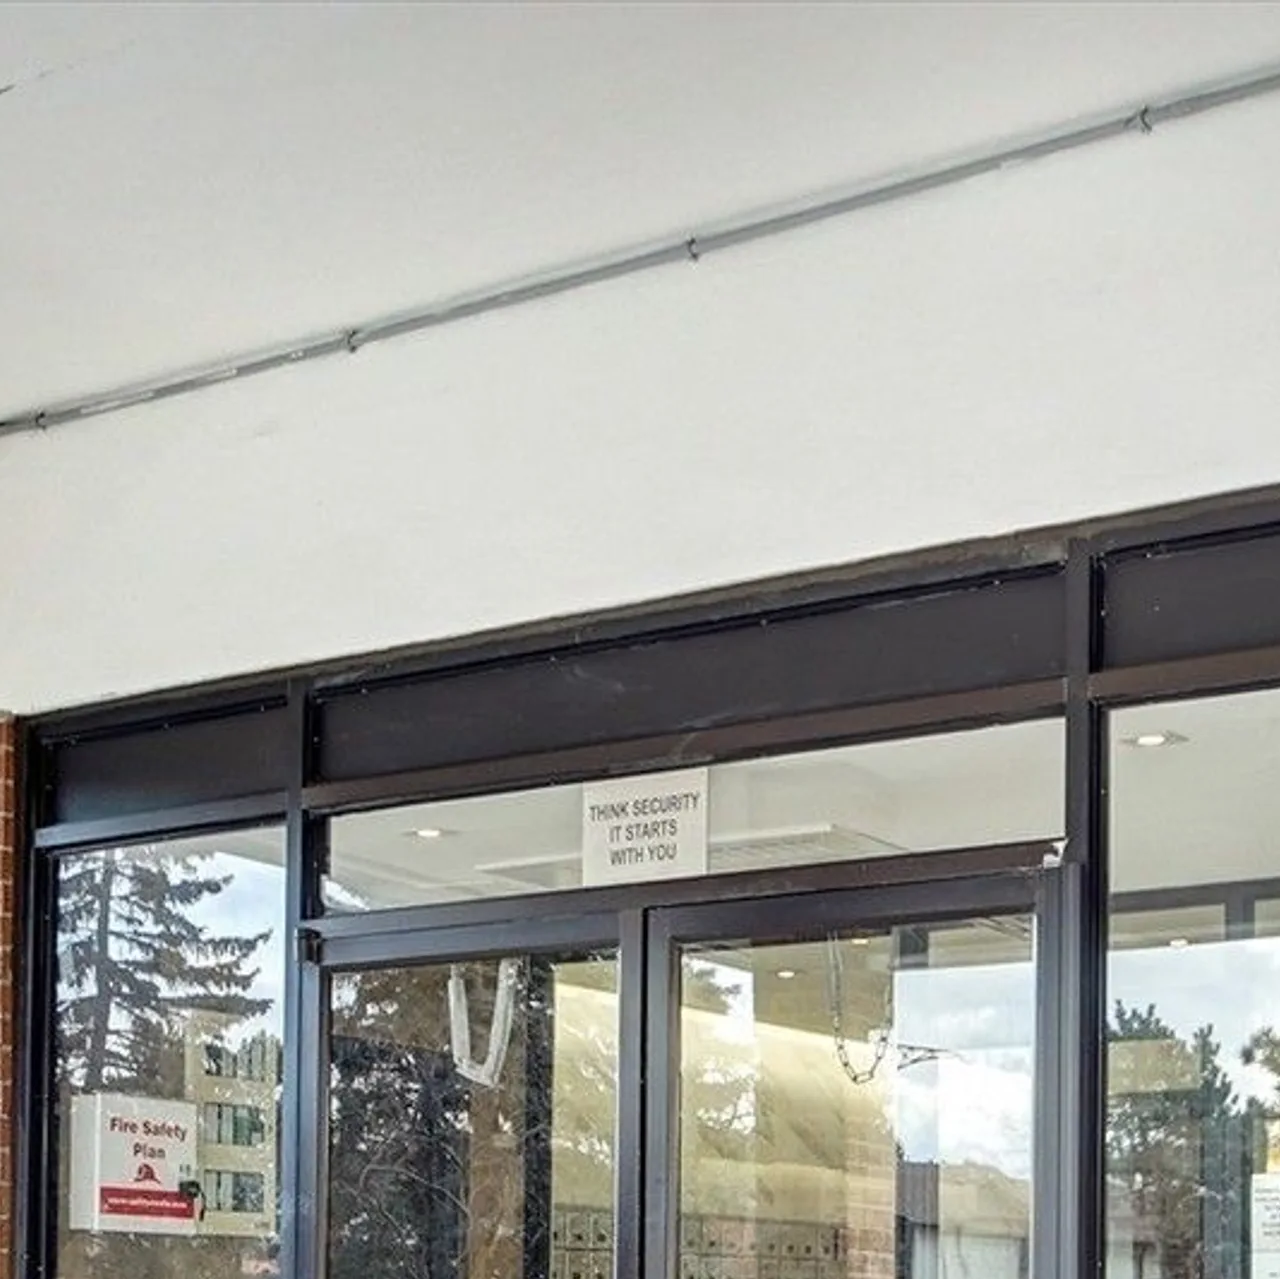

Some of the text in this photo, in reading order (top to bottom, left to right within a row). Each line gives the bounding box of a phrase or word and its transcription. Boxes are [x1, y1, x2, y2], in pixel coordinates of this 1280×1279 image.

[589, 792, 699, 822] THINK SECURITY
[609, 818, 677, 842] IT STARTS
[609, 844, 677, 866] WITH YOU
[109, 1116, 188, 1141] Fire Safety
[132, 1142, 166, 1160] Plan
